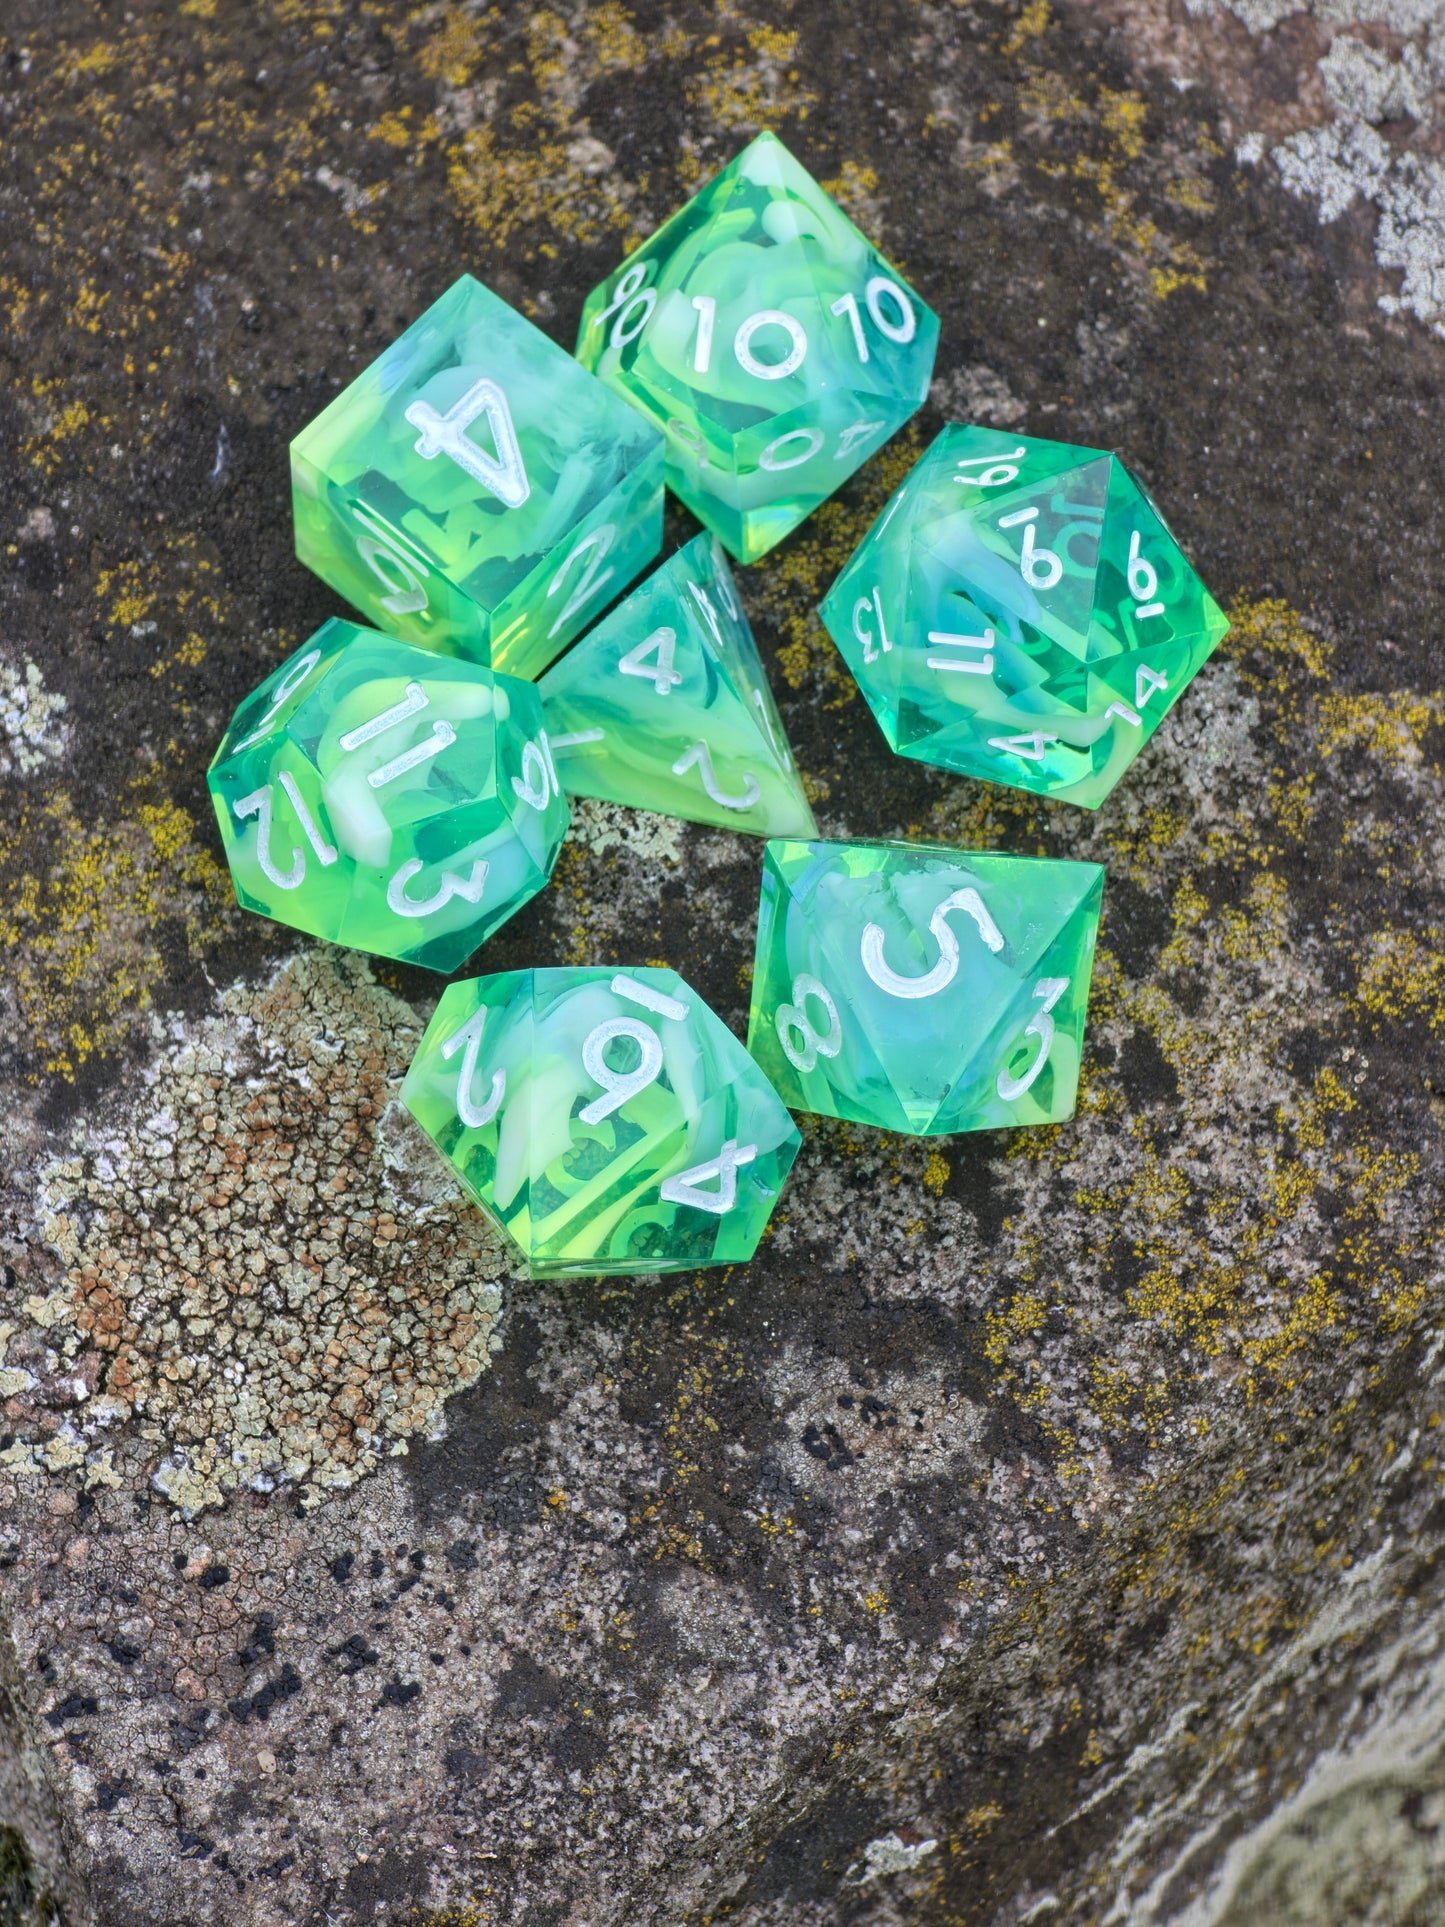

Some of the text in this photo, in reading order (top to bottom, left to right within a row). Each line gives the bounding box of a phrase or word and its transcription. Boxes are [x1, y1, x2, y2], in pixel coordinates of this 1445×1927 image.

[692, 296, 807, 380] 10
[404, 377, 531, 509] 4
[546, 523, 616, 640] 2
[1127, 530, 1165, 619] 6
[618, 627, 682, 695] 4
[926, 628, 996, 676] 11
[1104, 664, 1168, 727] 14
[338, 682, 457, 788] 11
[672, 738, 761, 809] 2
[987, 730, 1058, 761] 4
[232, 770, 338, 890] 12
[387, 857, 490, 917] 3
[861, 887, 1005, 999] 5
[442, 1004, 507, 1129] 2
[775, 973, 842, 1073] 8
[996, 977, 1070, 1101] 3
[660, 1138, 758, 1214] 4
